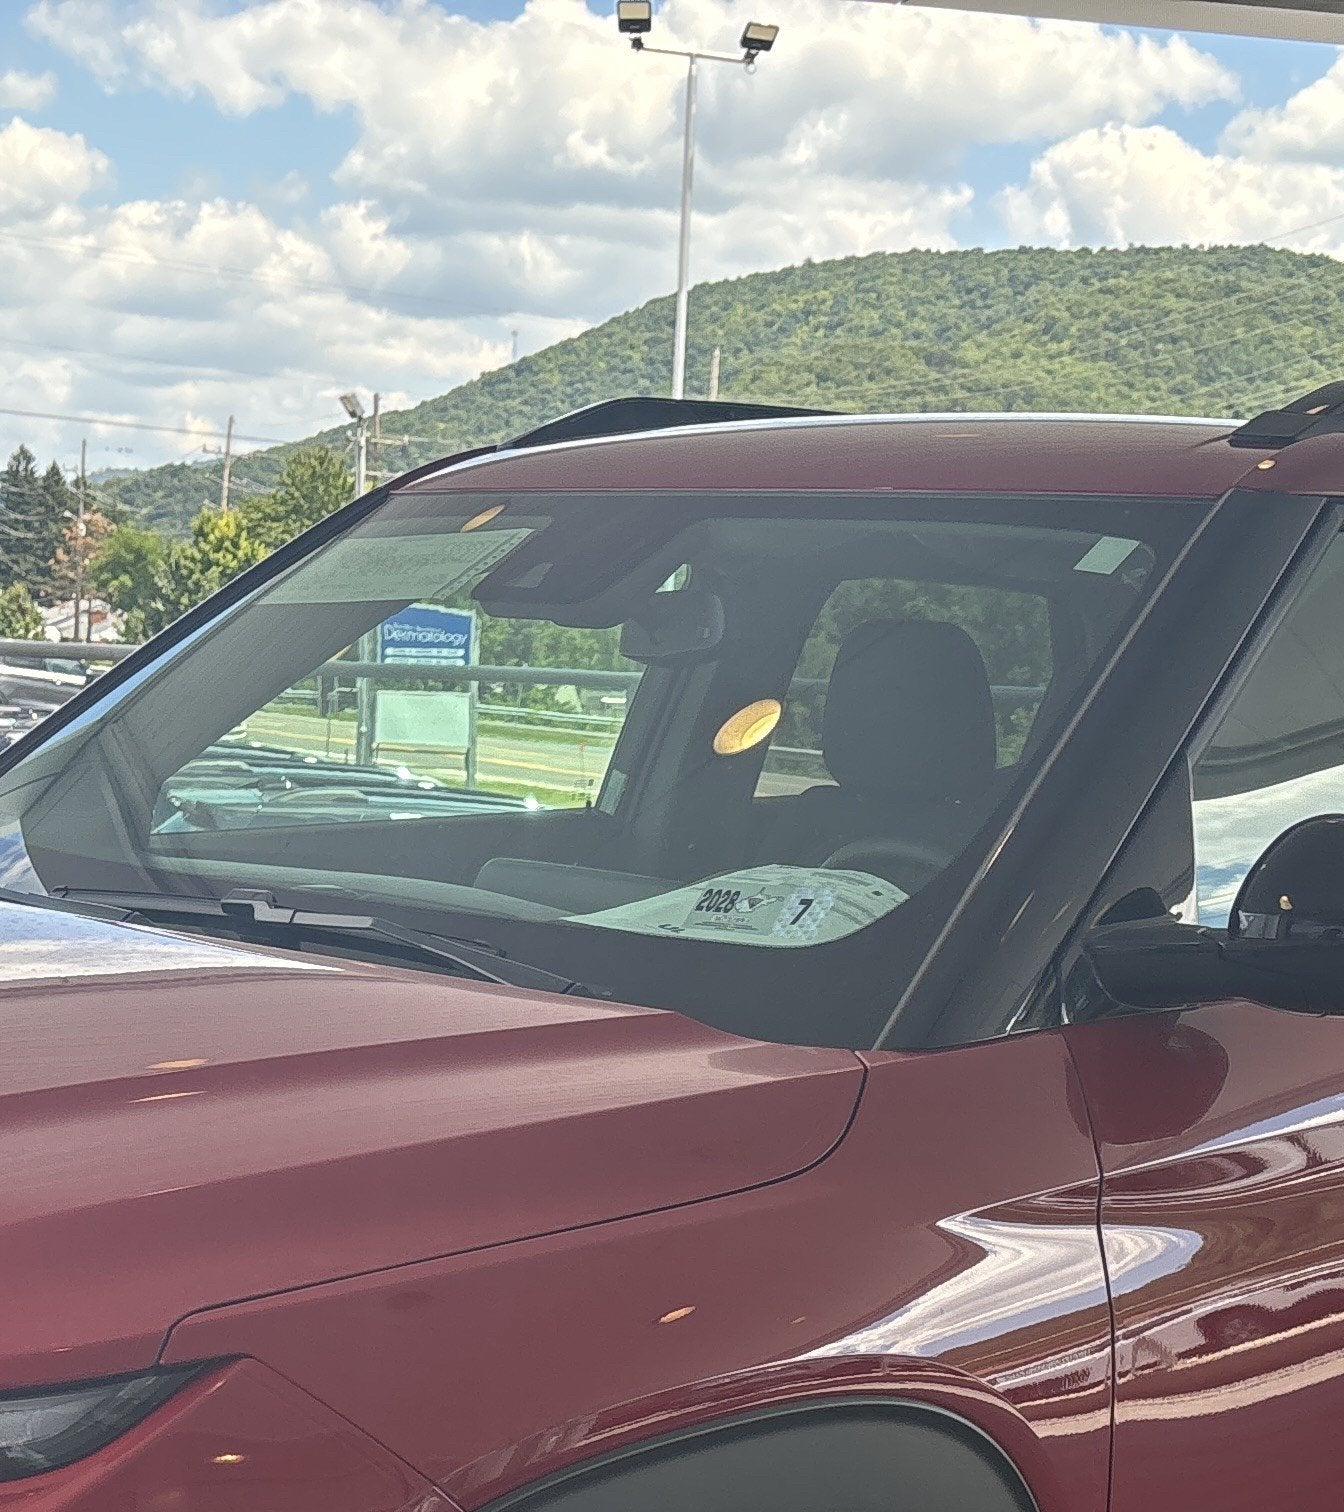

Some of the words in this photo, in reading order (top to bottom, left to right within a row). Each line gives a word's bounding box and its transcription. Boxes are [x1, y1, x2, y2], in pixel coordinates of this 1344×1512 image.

[383, 623, 469, 647] Dermatology
[694, 888, 741, 914] 2028
[789, 898, 815, 926] 7
